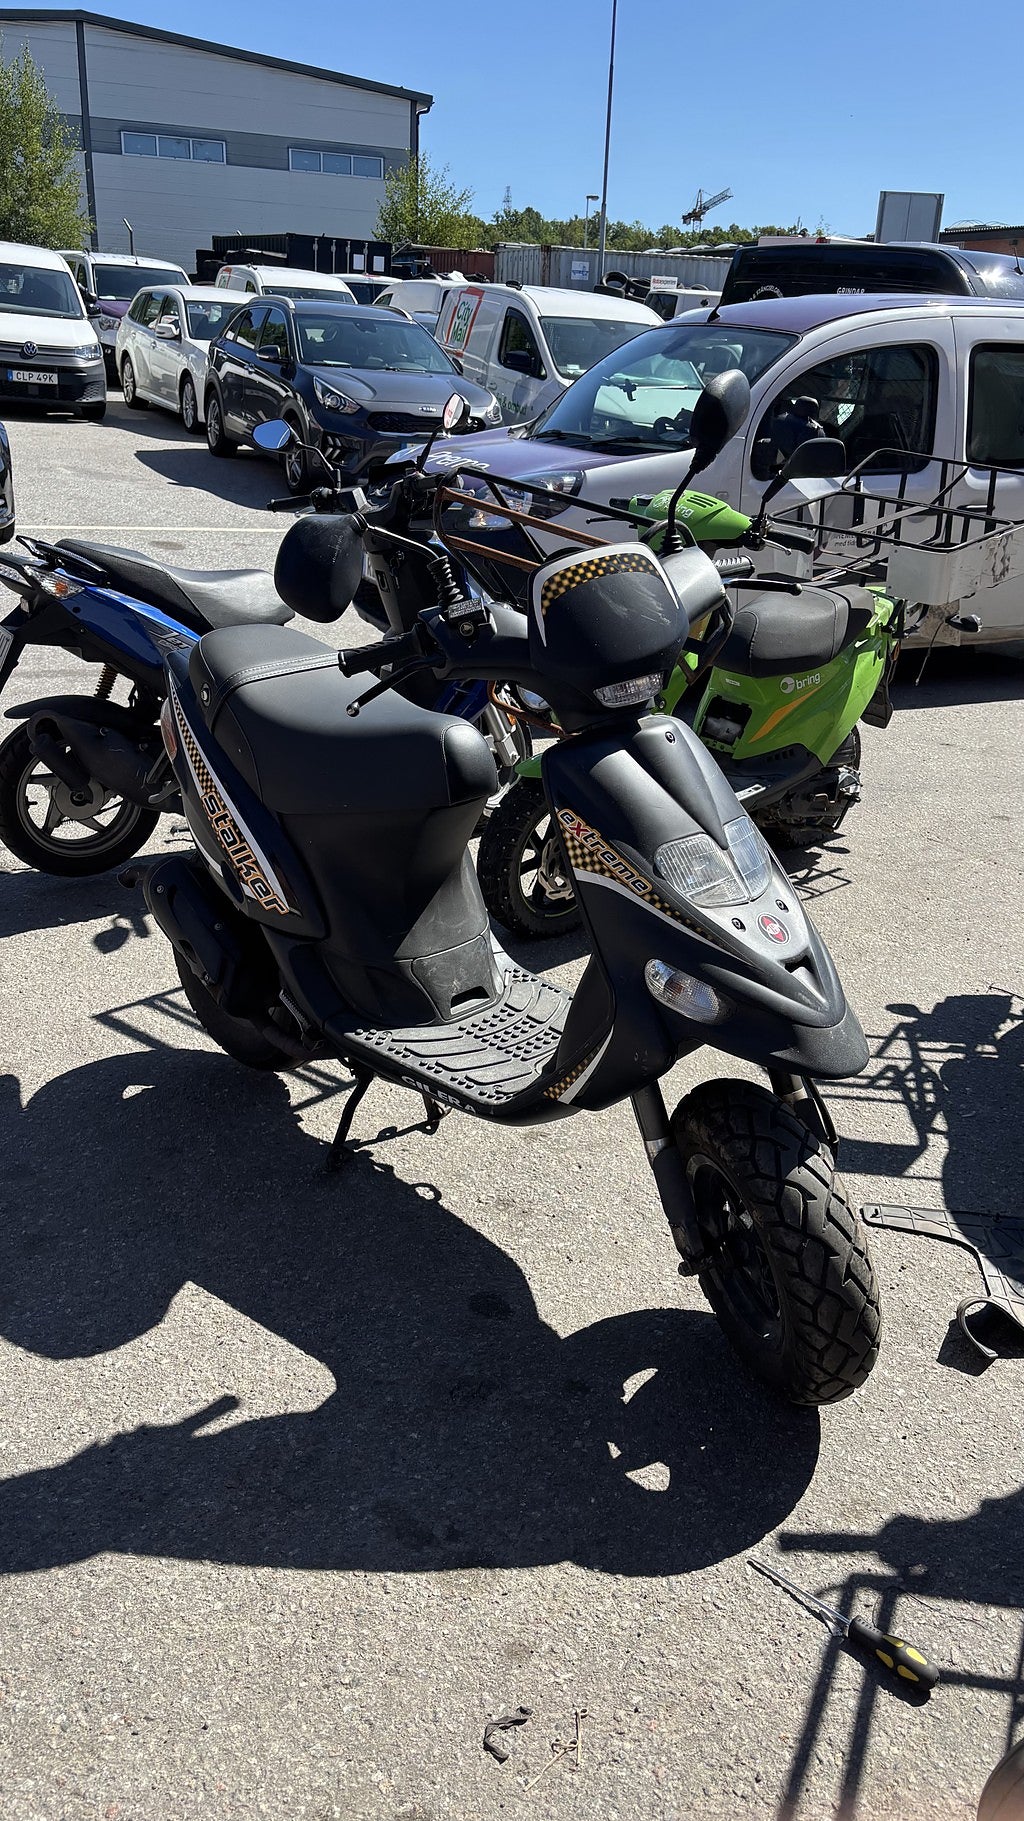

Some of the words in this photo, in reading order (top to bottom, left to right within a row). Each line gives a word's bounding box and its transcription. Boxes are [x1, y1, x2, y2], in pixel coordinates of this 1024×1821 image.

[457, 301, 474, 326] City
[16, 371, 34, 381] CLP
[37, 373, 54, 383] 49K
[796, 672, 821, 690] bring
[201, 791, 290, 915] stalker
[558, 808, 652, 896] extreme
